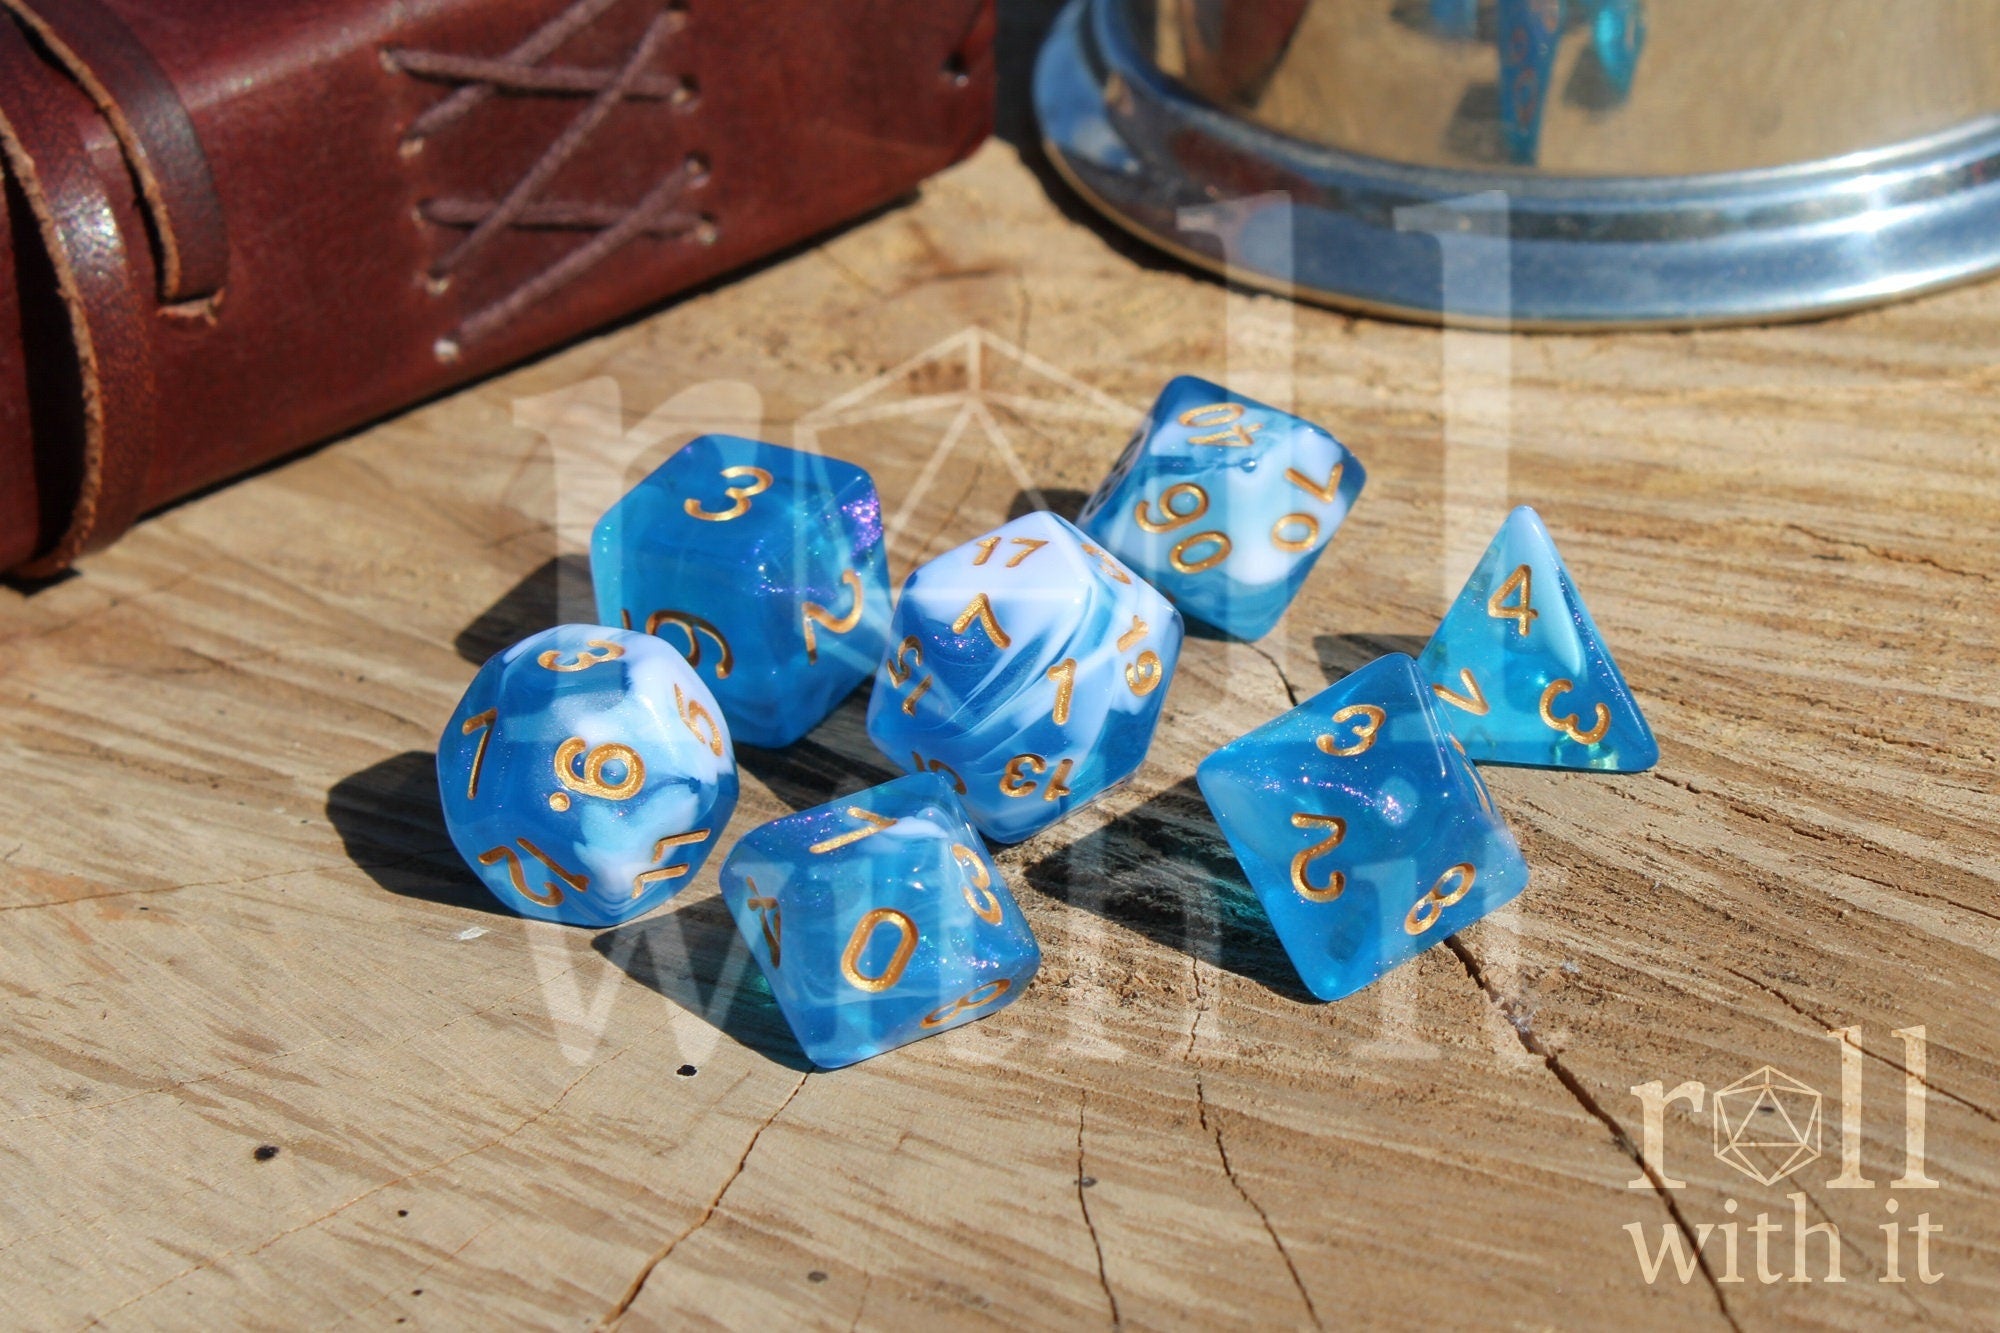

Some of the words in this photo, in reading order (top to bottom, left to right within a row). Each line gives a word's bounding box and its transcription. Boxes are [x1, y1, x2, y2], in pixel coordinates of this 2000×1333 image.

[684, 466, 773, 521] 3
[973, 536, 1049, 568] 17
[804, 569, 863, 665] 2
[952, 592, 1011, 648] 7
[1487, 564, 1539, 636] 4
[538, 640, 625, 672] 3
[674, 683, 723, 757] 5
[1047, 658, 1077, 726] 1
[1539, 679, 1611, 745] 3
[1316, 705, 1386, 757] 3
[952, 843, 1003, 926] 3
[1290, 812, 1347, 902] 2
[1404, 862, 1476, 936] 8
[841, 907, 919, 993] 0
[919, 978, 1011, 1029] 8
